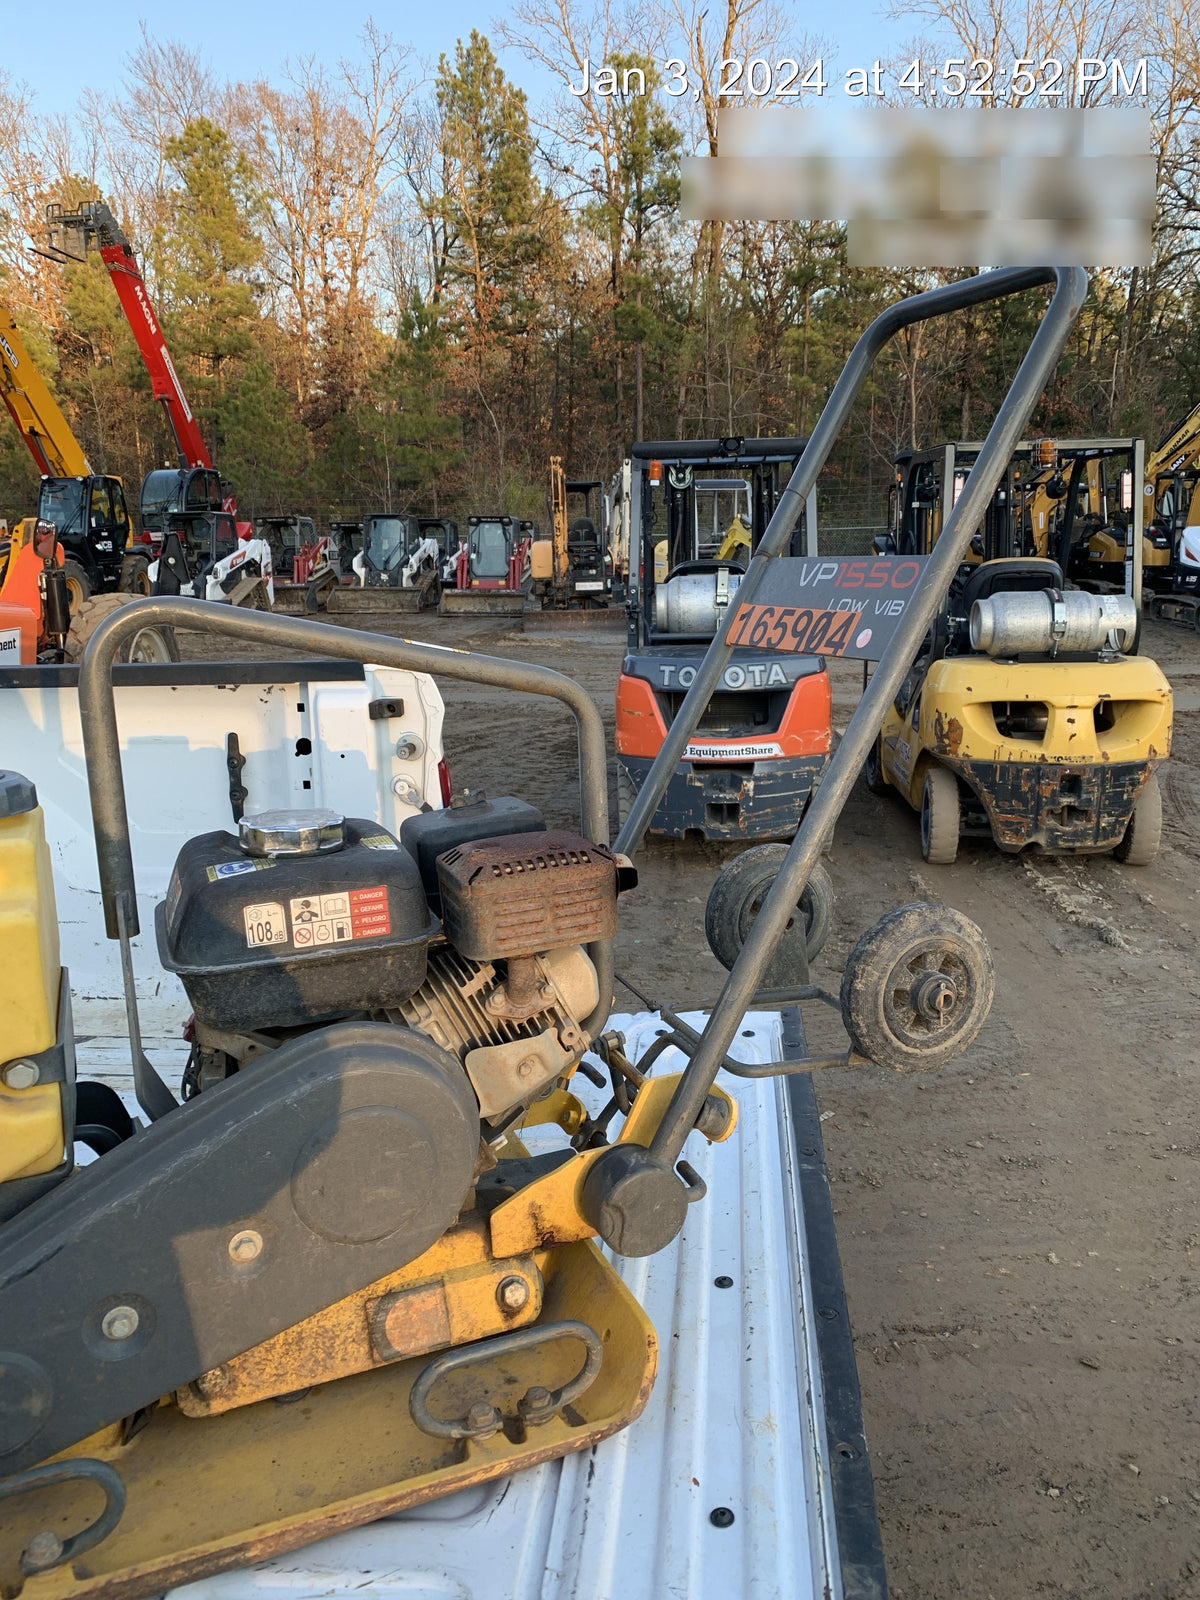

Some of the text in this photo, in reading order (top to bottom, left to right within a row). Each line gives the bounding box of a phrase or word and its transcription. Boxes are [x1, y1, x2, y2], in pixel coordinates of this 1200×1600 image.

[134, 285, 157, 335] MAGNI
[1165, 429, 1190, 455] YANMAR
[800, 562, 920, 588] VP1550
[826, 598, 905, 616] LOW VIB
[735, 604, 855, 656] 165904
[659, 662, 788, 688] TOOTA
[689, 746, 774, 758] EquipmentShare
[359, 891, 384, 900] DANGER
[361, 914, 387, 924] PELIGRO
[249, 920, 284, 943] 108 dB
[362, 926, 387, 936] DANGER
